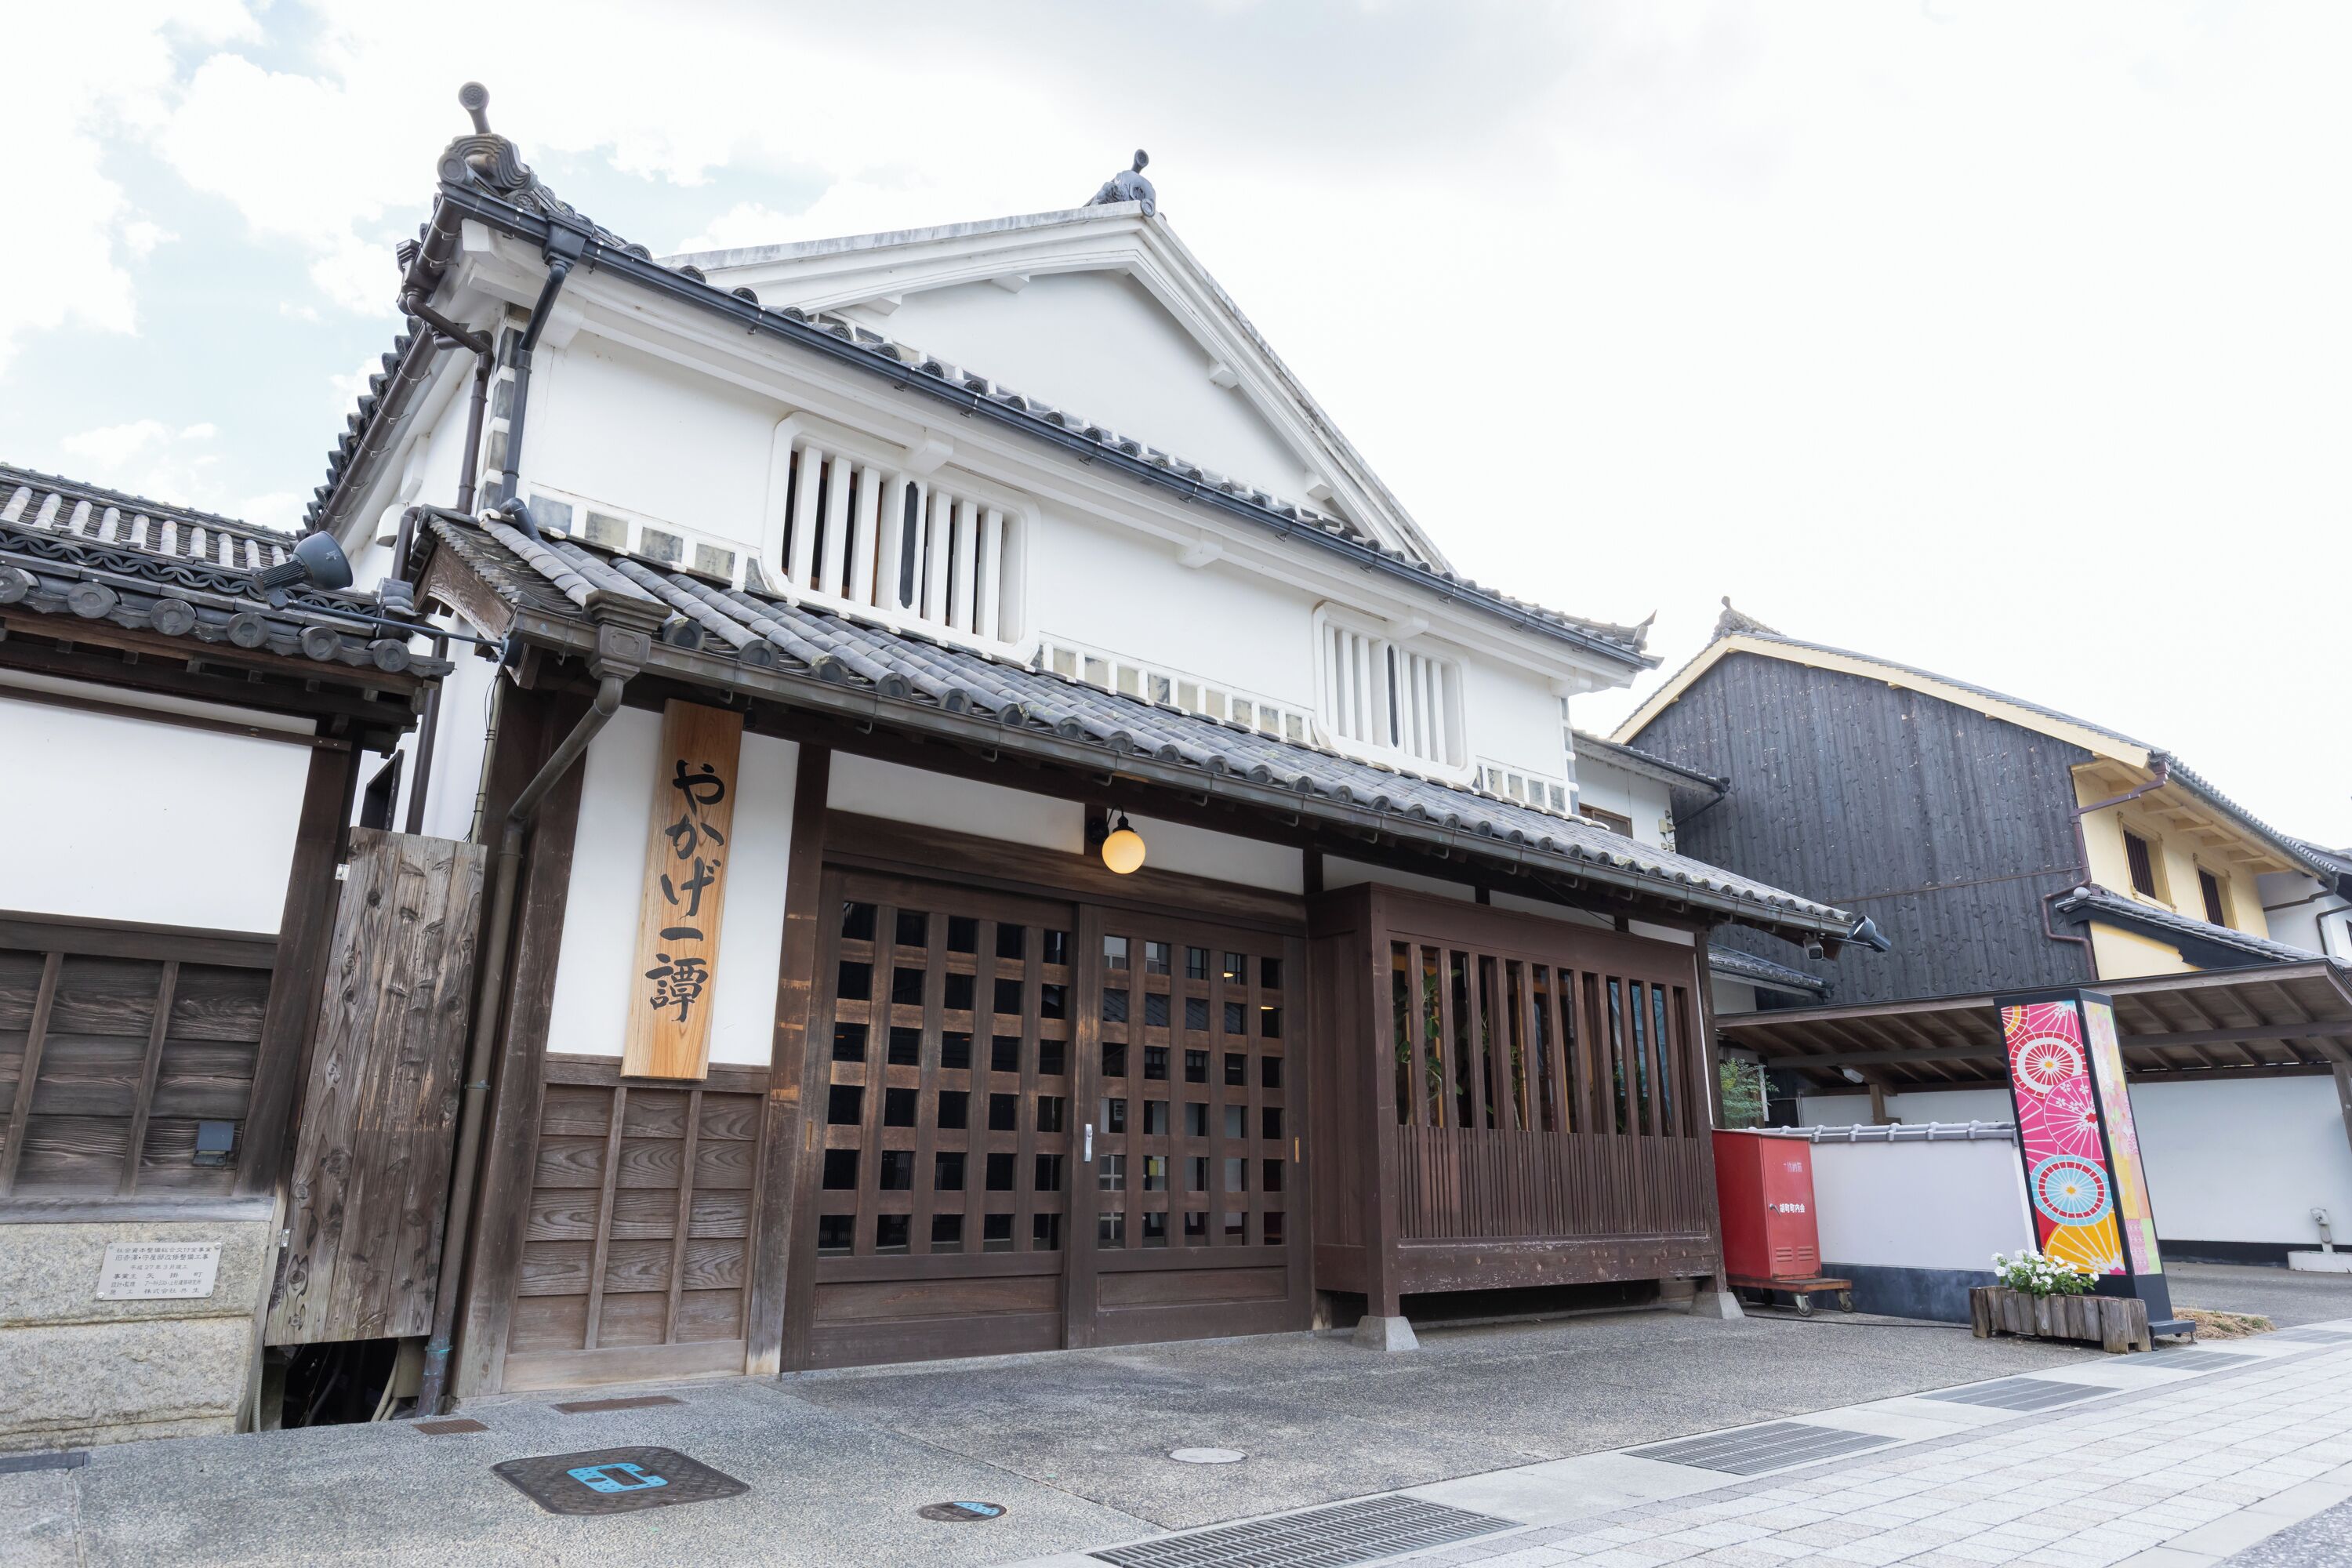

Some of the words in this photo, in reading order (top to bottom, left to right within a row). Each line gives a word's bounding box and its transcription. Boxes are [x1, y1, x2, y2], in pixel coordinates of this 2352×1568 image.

[644, 759, 726, 1022] やかげ一譚
